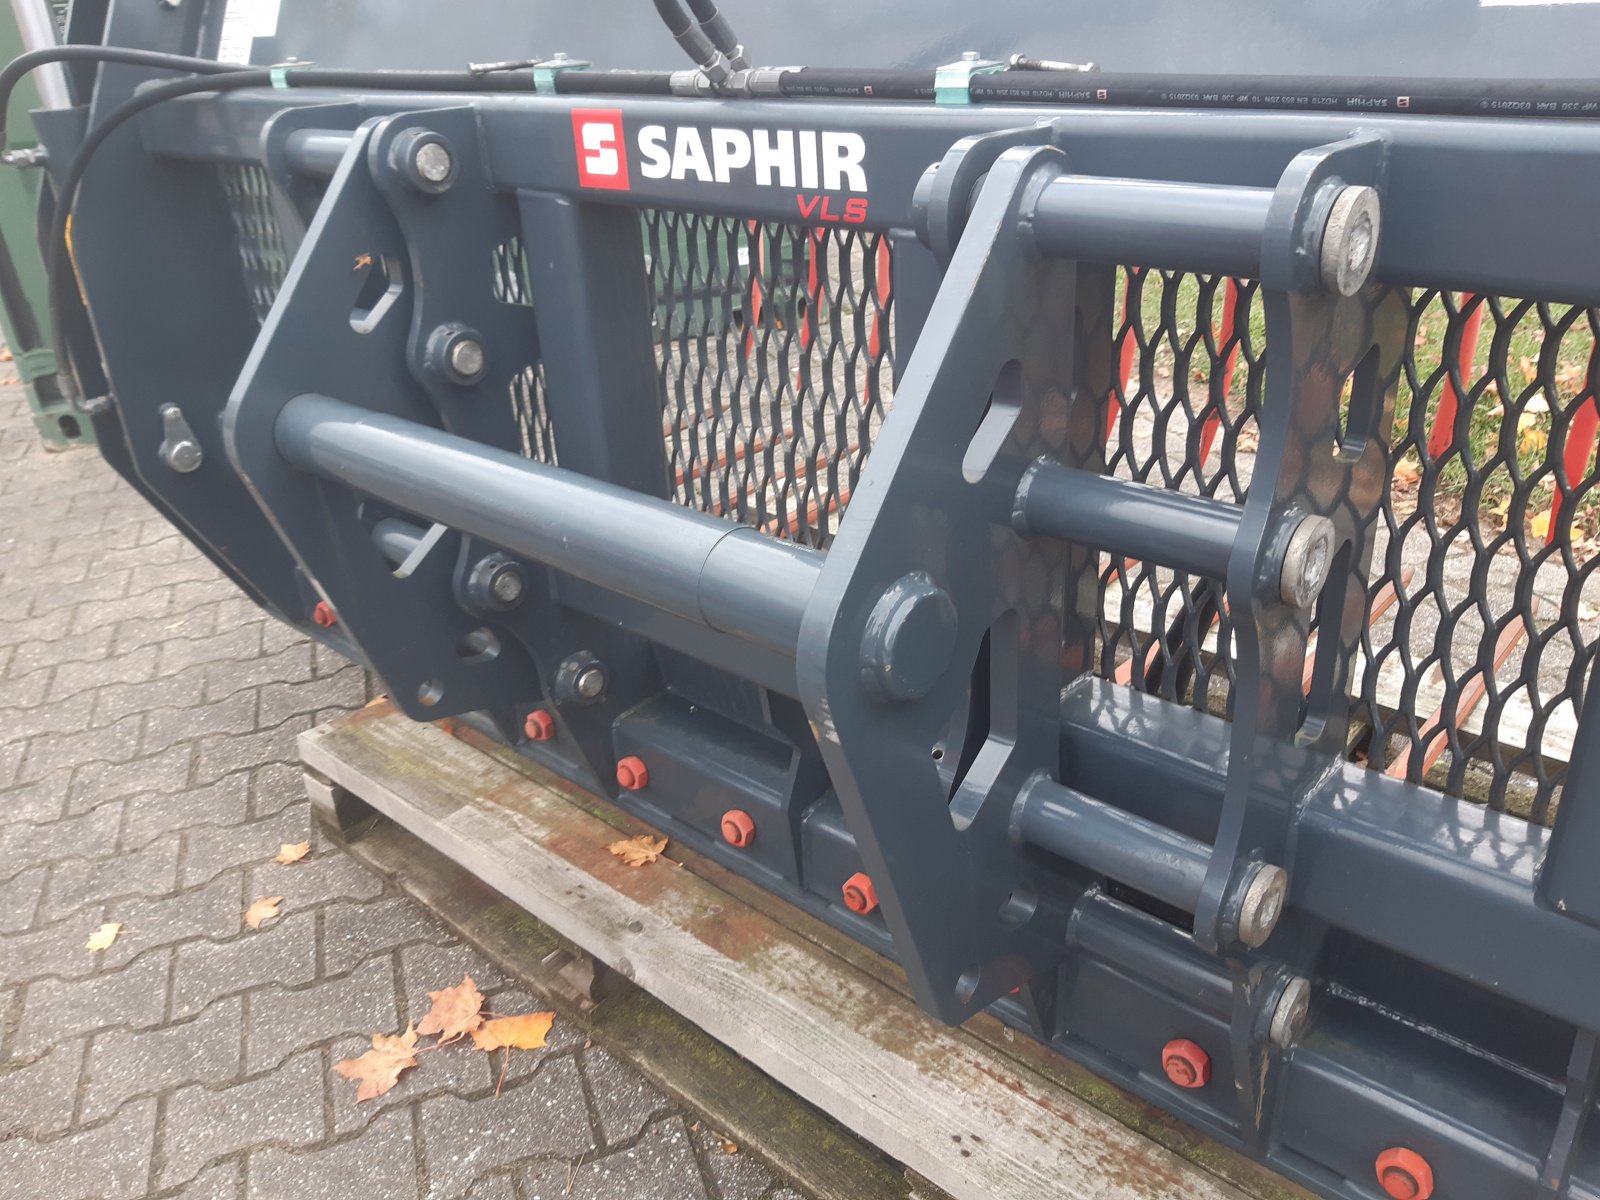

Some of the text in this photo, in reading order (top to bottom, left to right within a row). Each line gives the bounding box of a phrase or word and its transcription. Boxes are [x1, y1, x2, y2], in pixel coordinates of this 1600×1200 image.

[1058, 90, 1091, 99] SAPHIR
[1311, 97, 1338, 105] HD210
[1346, 97, 1388, 106] SAPHIR
[1491, 101, 1531, 110] 03Q2015
[1536, 102, 1557, 110] BAR
[1561, 102, 1580, 110] 330
[637, 125, 868, 192] SAPHIR
[796, 194, 868, 224] VLS
